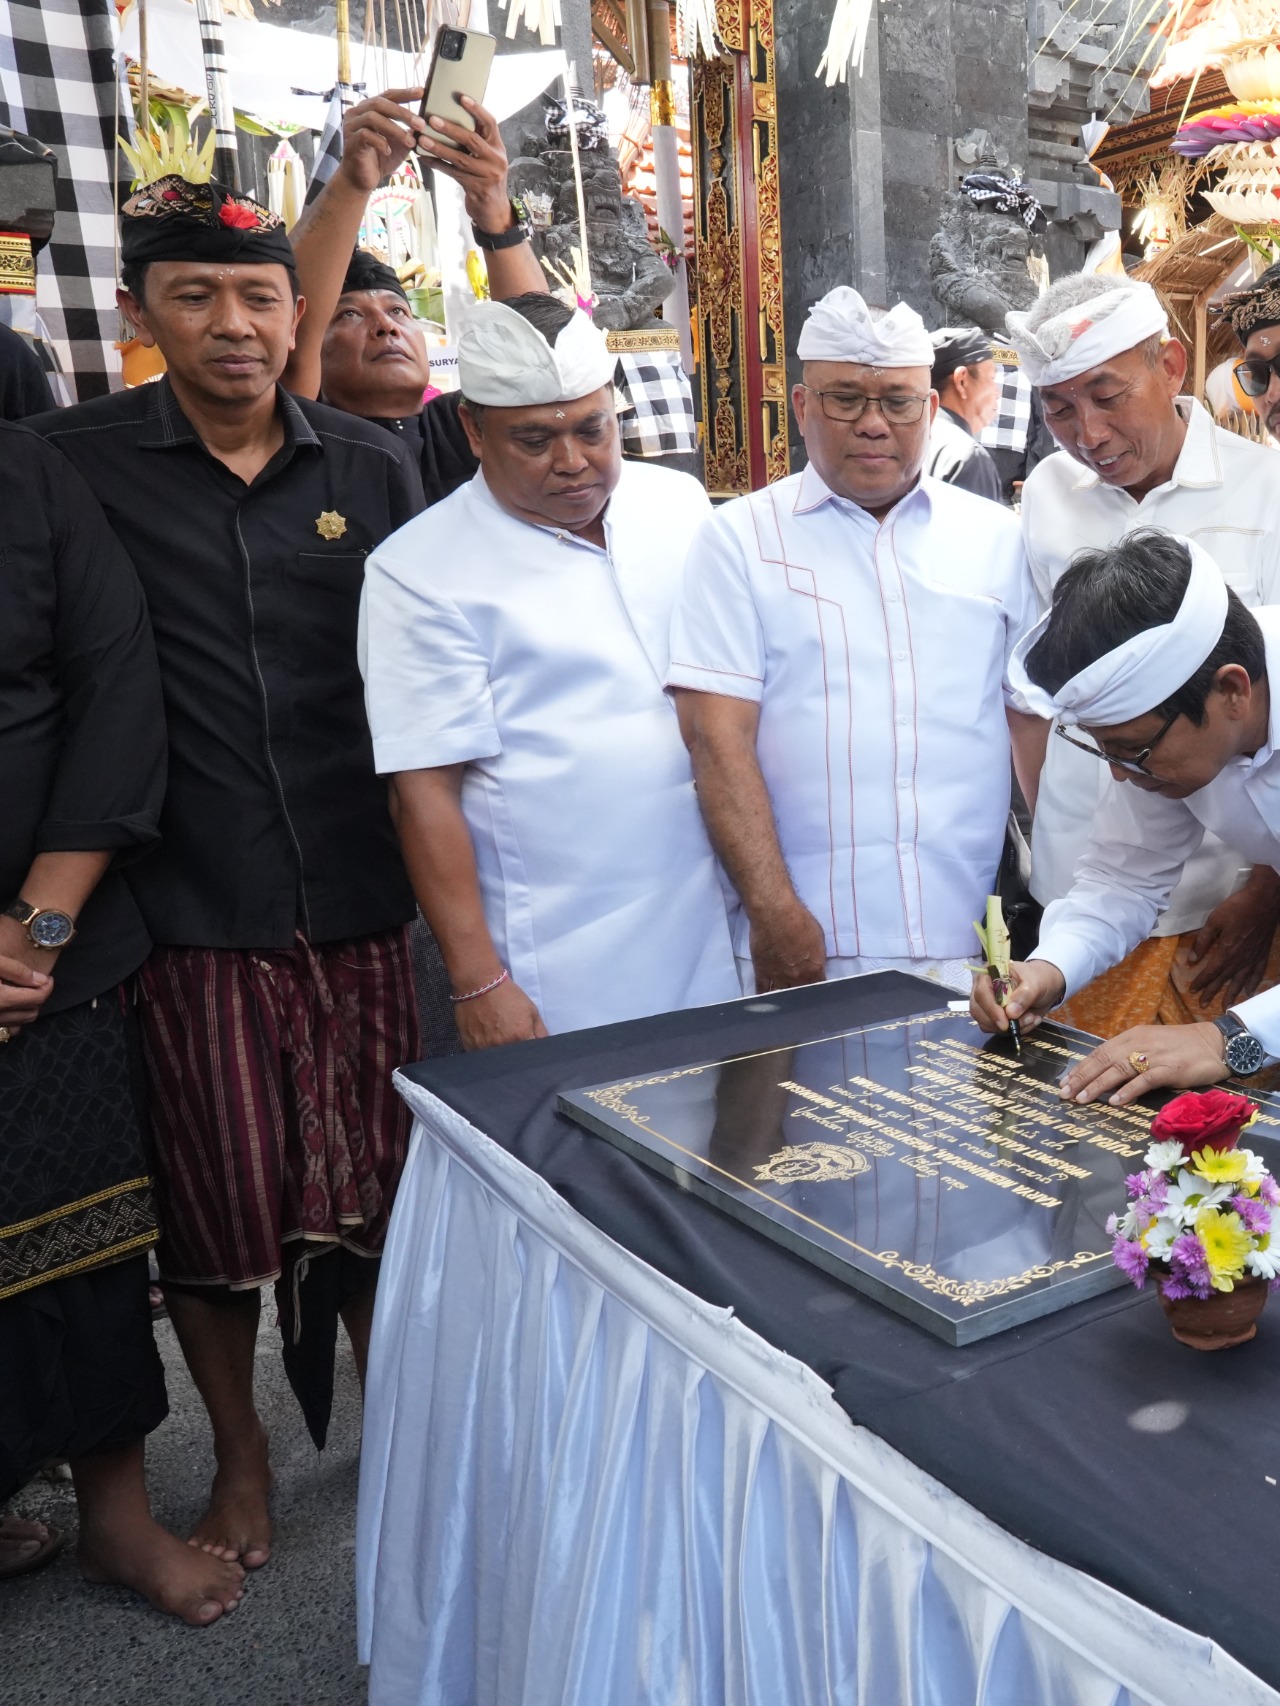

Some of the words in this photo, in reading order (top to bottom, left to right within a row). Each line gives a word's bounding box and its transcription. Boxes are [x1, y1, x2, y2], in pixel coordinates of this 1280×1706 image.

[937, 1038, 988, 1055] BADUNG
[935, 1048, 1005, 1072] SEPTEMBER
[978, 1052, 1025, 1068] BUPATI
[902, 1064, 962, 1086] BUALU
[948, 1082, 1016, 1107] DUKUH
[908, 1102, 938, 1113] RSI
[927, 1110, 969, 1126] CARU
[1002, 1103, 1063, 1125] PANTI
[1084, 1101, 1131, 1118] WUKU
[876, 1125, 940, 1151] NGENTEG
[958, 1123, 994, 1136] LAN
[1050, 1122, 1094, 1138] IBU
[982, 1132, 1032, 1152] KALPA
[1081, 1134, 1145, 1157] PURA
[927, 1147, 1022, 1187] MEMUNGKAH,
[1020, 1148, 1095, 1178] WRASPATI
[1007, 1184, 1063, 1207] KARYA
